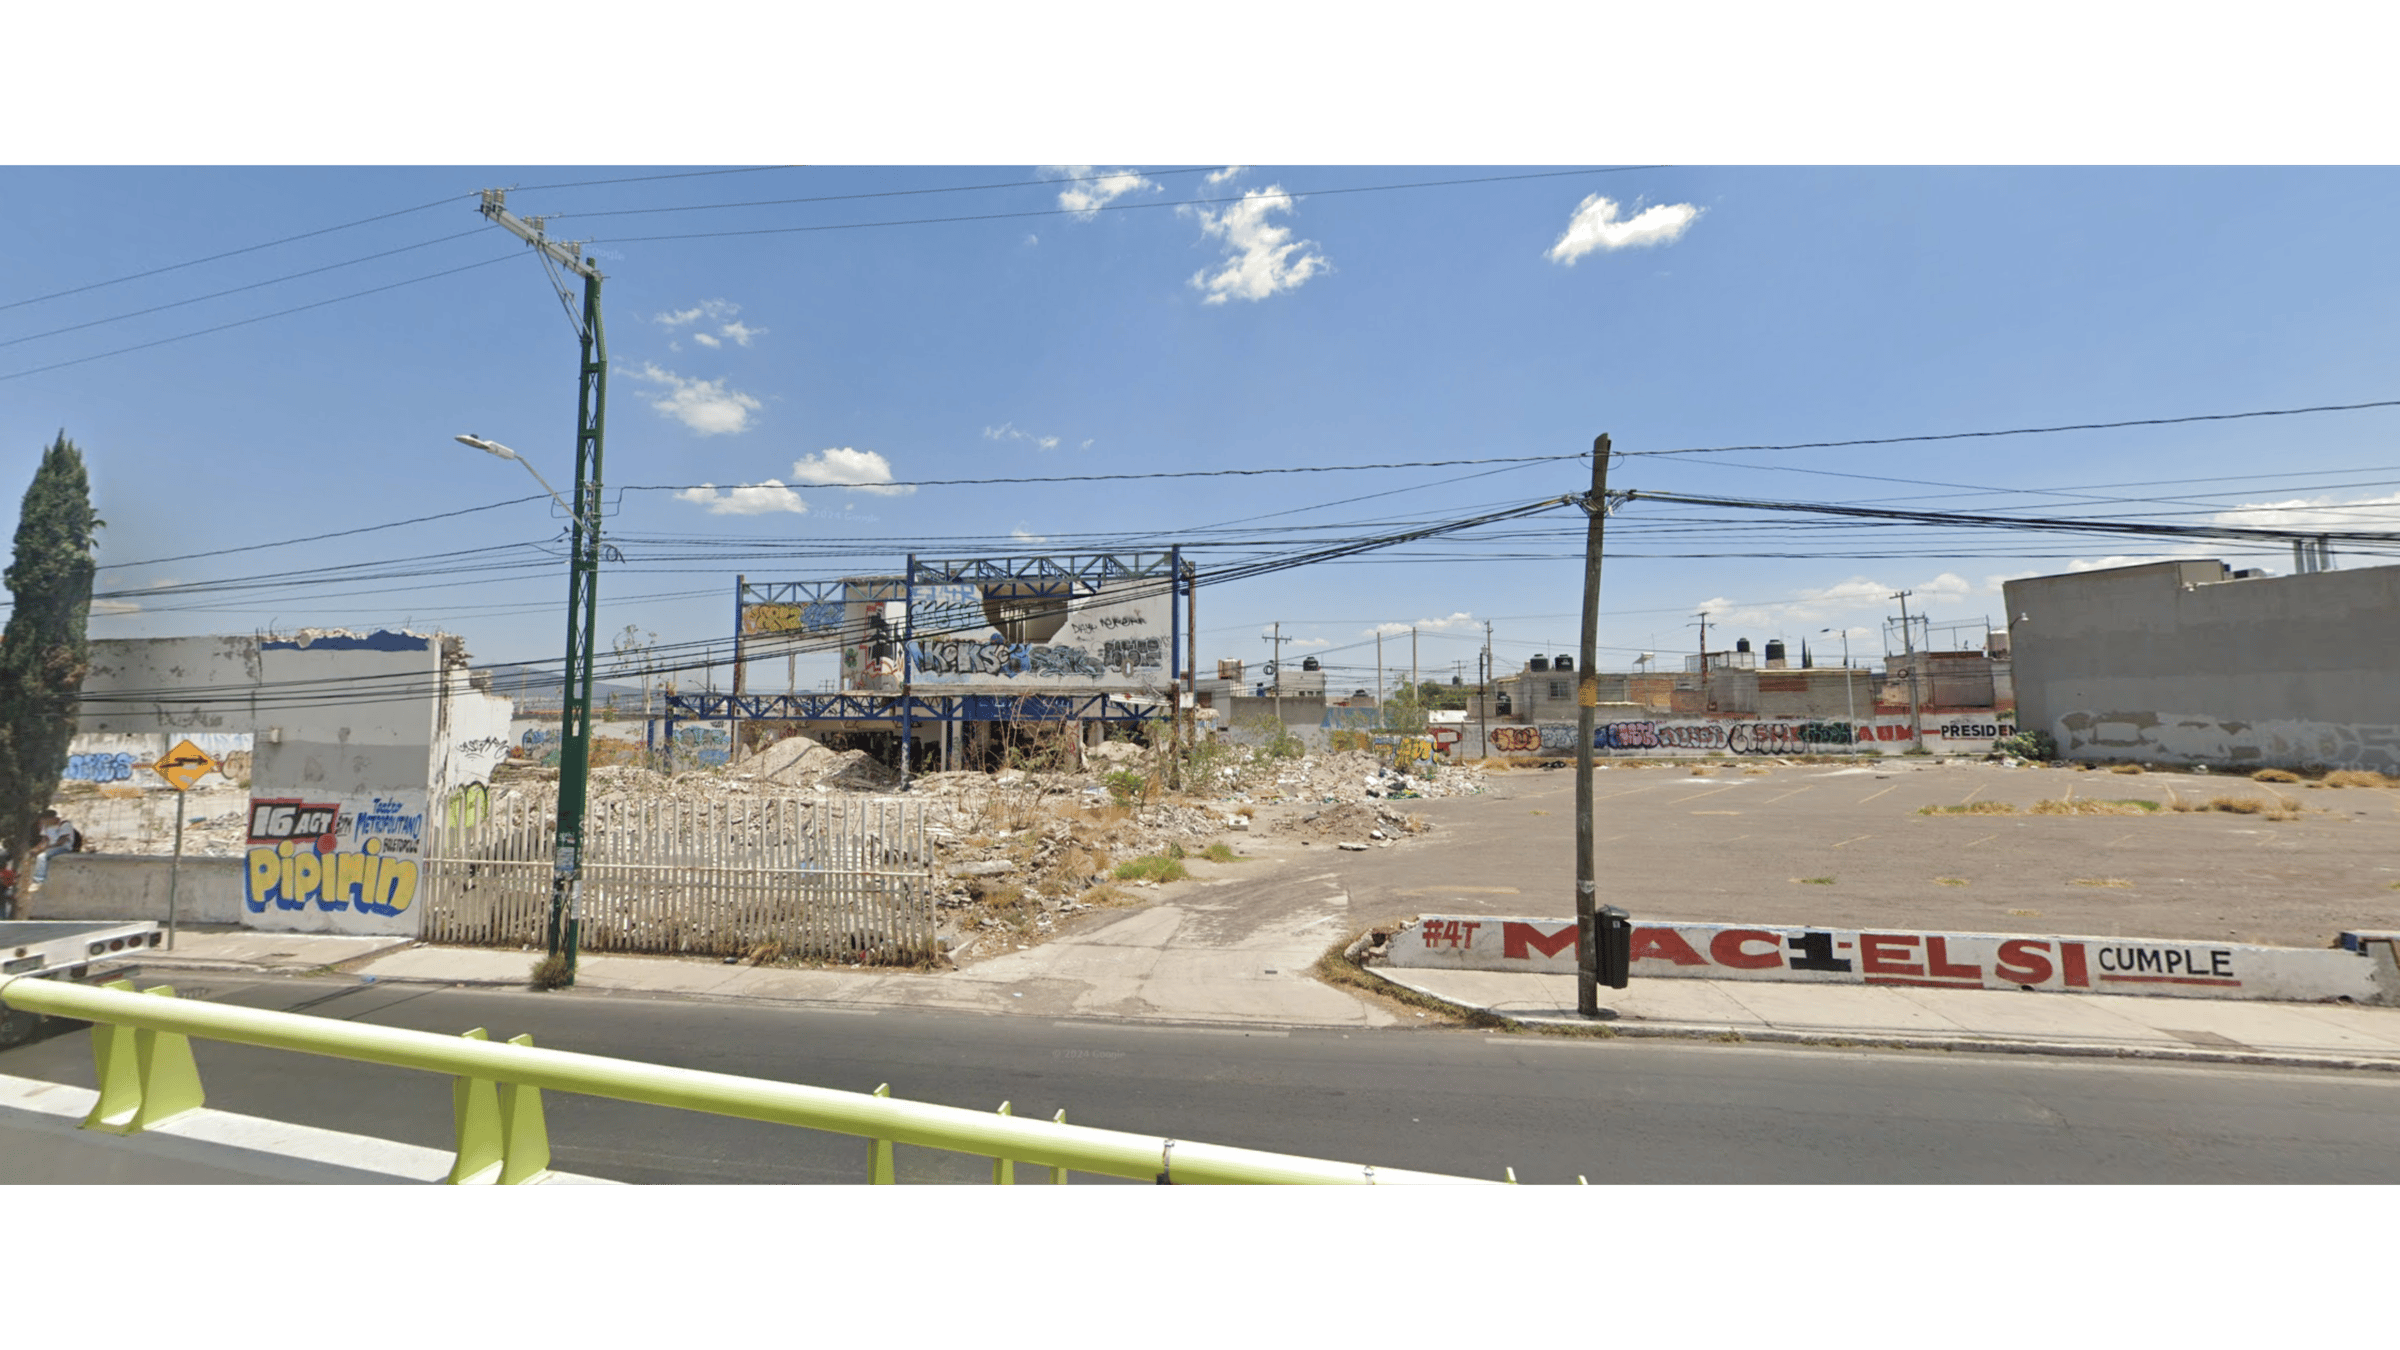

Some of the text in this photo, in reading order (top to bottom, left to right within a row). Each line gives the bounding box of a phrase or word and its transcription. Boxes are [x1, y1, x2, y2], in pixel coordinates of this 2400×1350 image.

[252, 806, 297, 837] 16
[294, 812, 333, 835] AGT
[1422, 919, 1481, 950] #4T
[2099, 946, 2234, 976] CUMPLE
